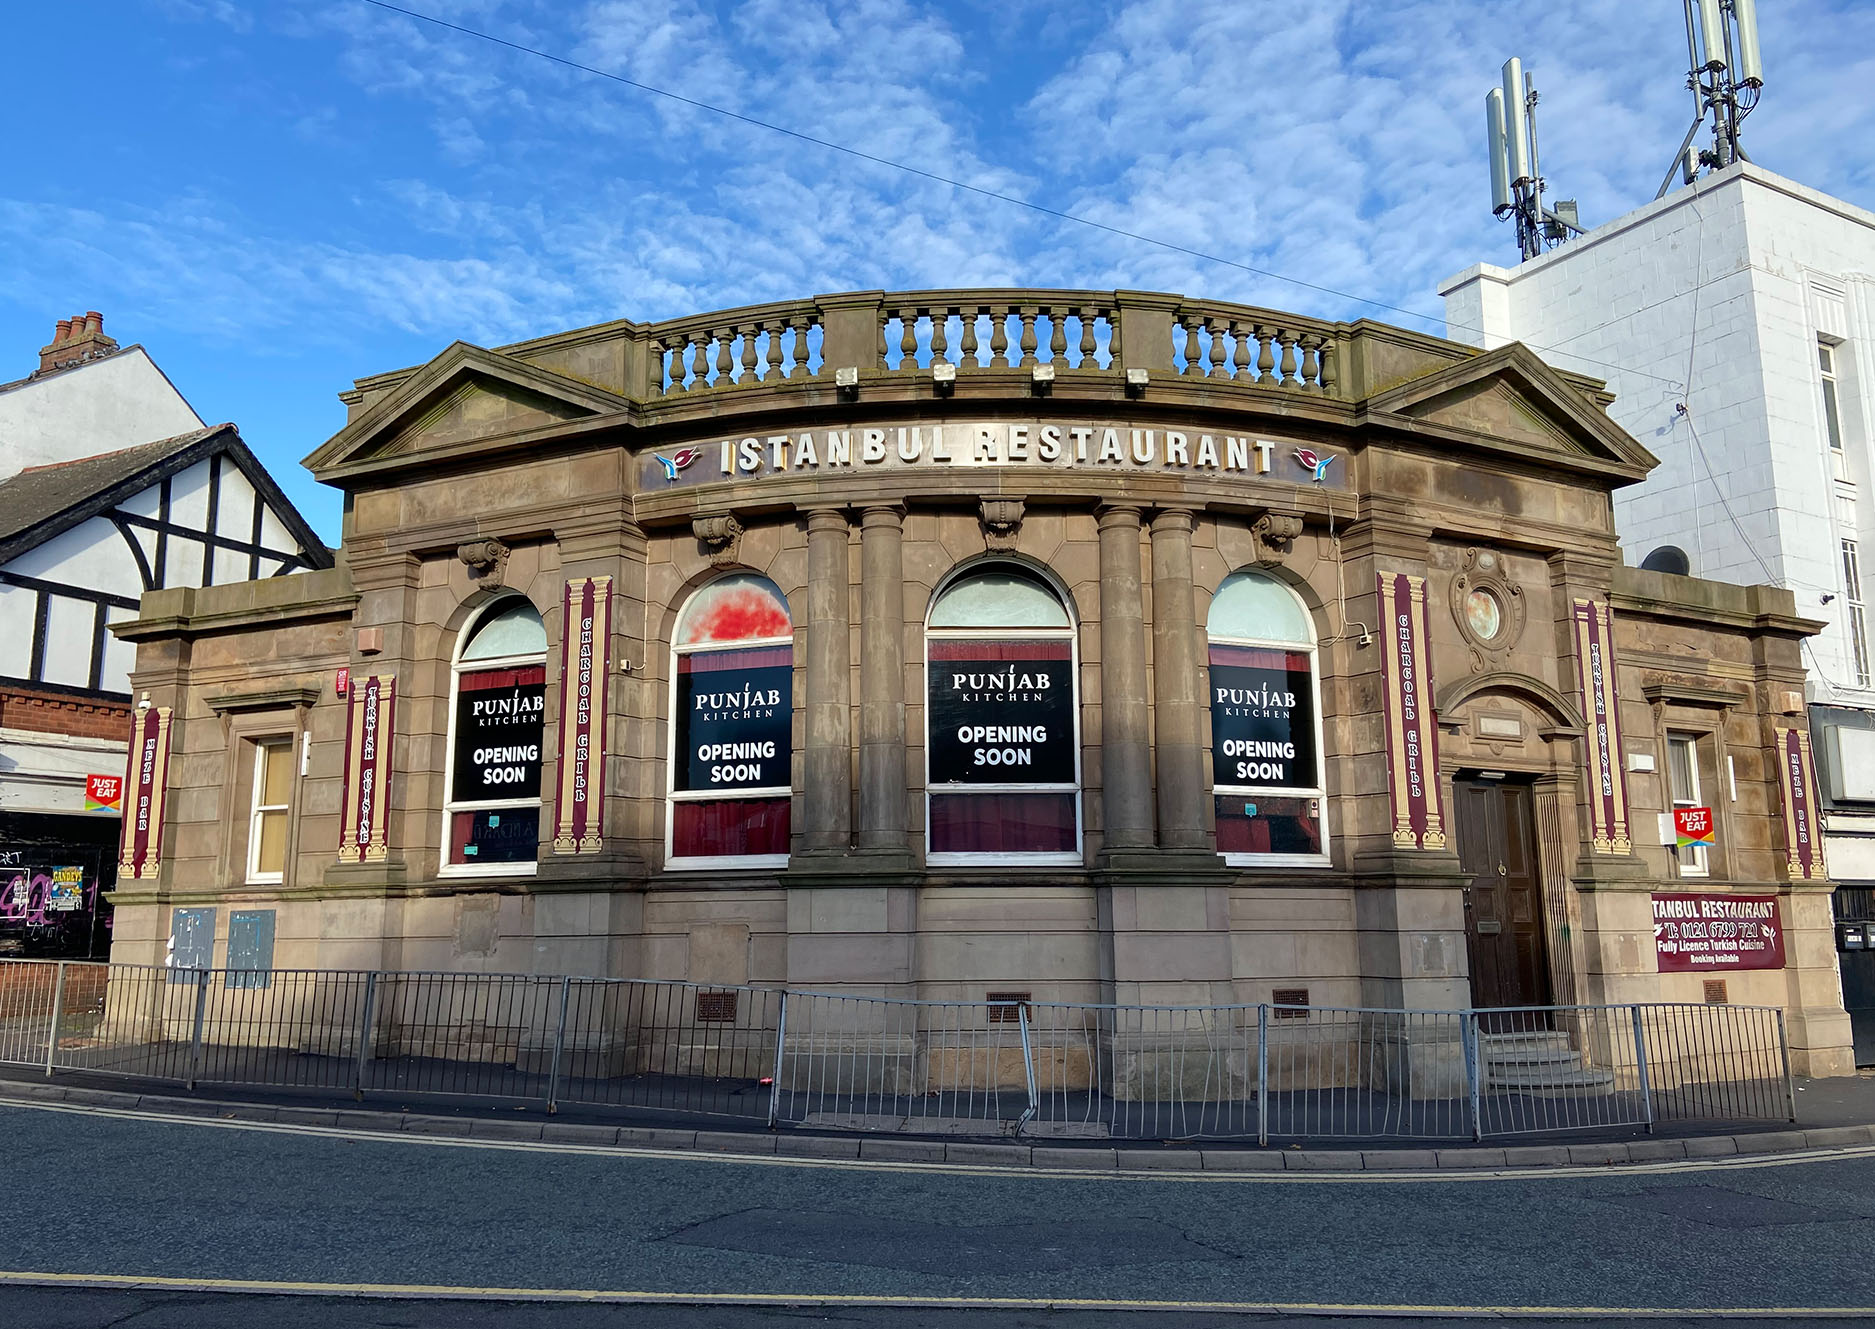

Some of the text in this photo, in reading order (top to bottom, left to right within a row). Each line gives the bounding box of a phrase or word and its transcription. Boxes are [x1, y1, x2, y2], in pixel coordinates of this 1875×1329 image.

[719, 426, 1276, 476] ISTANBUL RESTAURANT
[952, 664, 1051, 692] PUNJAB
[1591, 643, 1605, 714] TURKISH
[472, 689, 544, 716] PUNJAB
[695, 682, 781, 710] PUNJAB
[962, 693, 1042, 701] KITCHEN
[1216, 682, 1296, 709] PUNJAB
[575, 617, 593, 801] CHARCOAL GRILL
[703, 709, 773, 721] KITCHEN
[1225, 707, 1290, 719] KITCHEN
[1398, 614, 1421, 797] CHARCOAL GRILL
[479, 715, 537, 727] KITCHEN
[957, 725, 1047, 743] OPENING
[473, 744, 538, 765] OPENING
[698, 741, 776, 762] OPENING
[973, 748, 1031, 766] SOON
[1222, 739, 1296, 759] OPENING
[360, 686, 378, 844] TURKISH CUISINE
[710, 764, 761, 783] SOON
[1236, 761, 1284, 780] SOON
[91, 777, 118, 789] JUST
[138, 738, 155, 831] MEZE BAR
[482, 766, 526, 785] SOON
[96, 787, 117, 798] EAT
[1790, 753, 1808, 843] MEZE BAR
[1680, 810, 1706, 824] JUST
[1686, 821, 1708, 832] EAT
[1652, 900, 1775, 918] TANBUL RESTAURANT
[1680, 922, 1709, 939] 0121
[1709, 922, 1738, 938] 6799
[1739, 922, 1759, 938] 721
[1657, 939, 1765, 954] Fully Licence Turkish Cuisine
